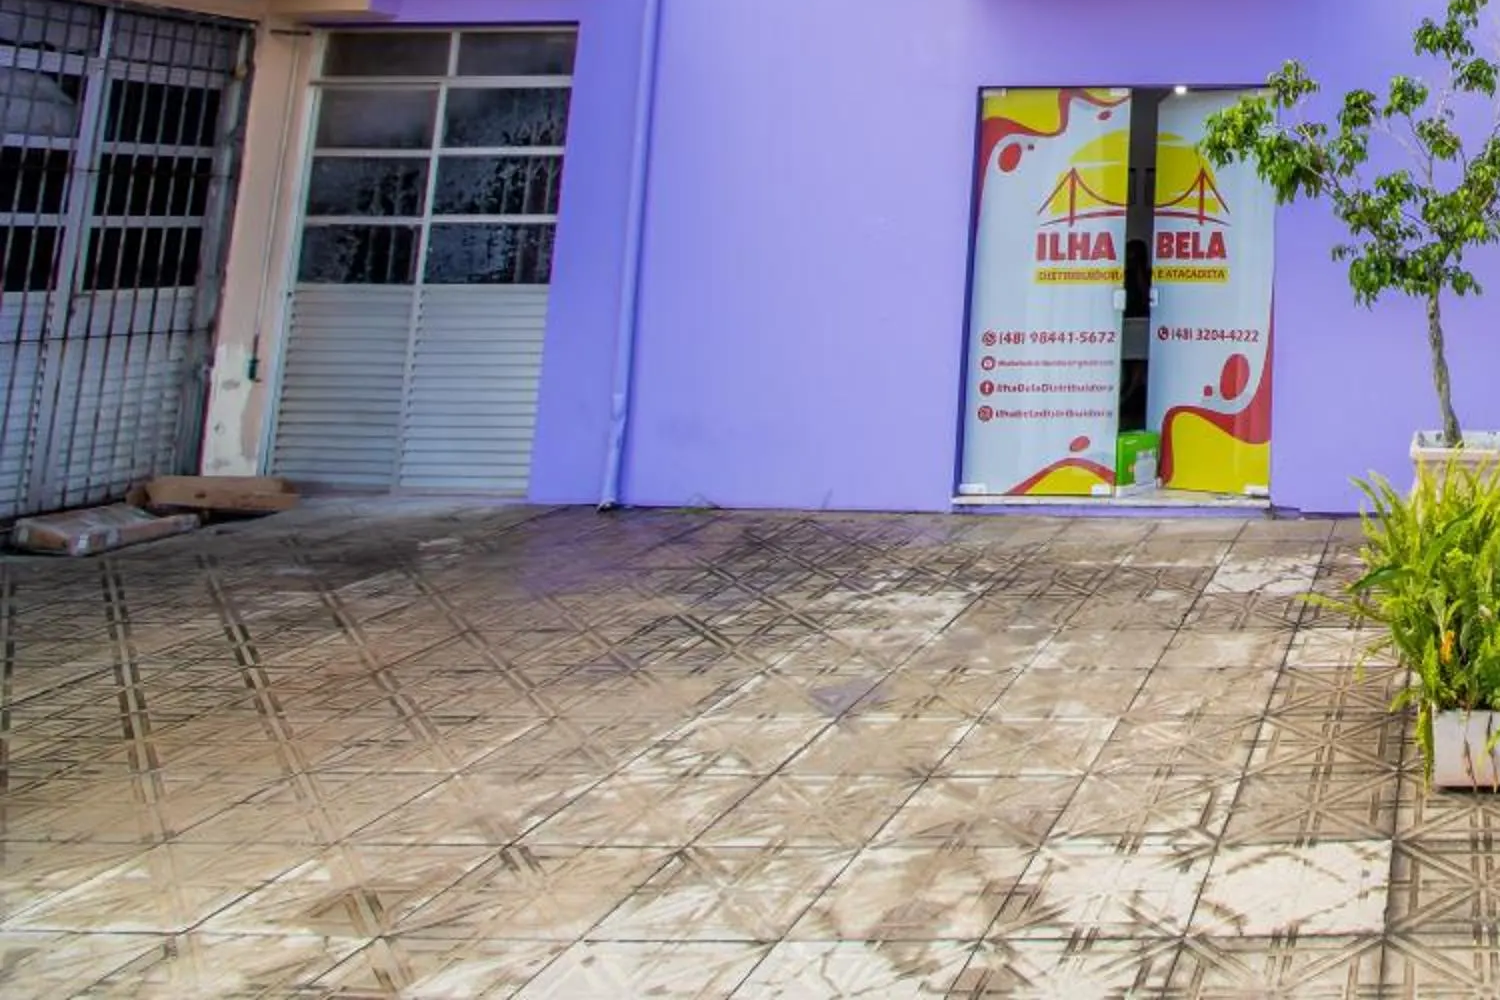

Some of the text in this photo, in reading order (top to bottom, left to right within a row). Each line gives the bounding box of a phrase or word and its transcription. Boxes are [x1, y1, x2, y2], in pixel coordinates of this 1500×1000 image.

[1035, 231, 1227, 261] ILHA BELA
[999, 331, 1116, 345] (48) 98441-5672
[1171, 327, 1260, 343] (48) 3204-4222
